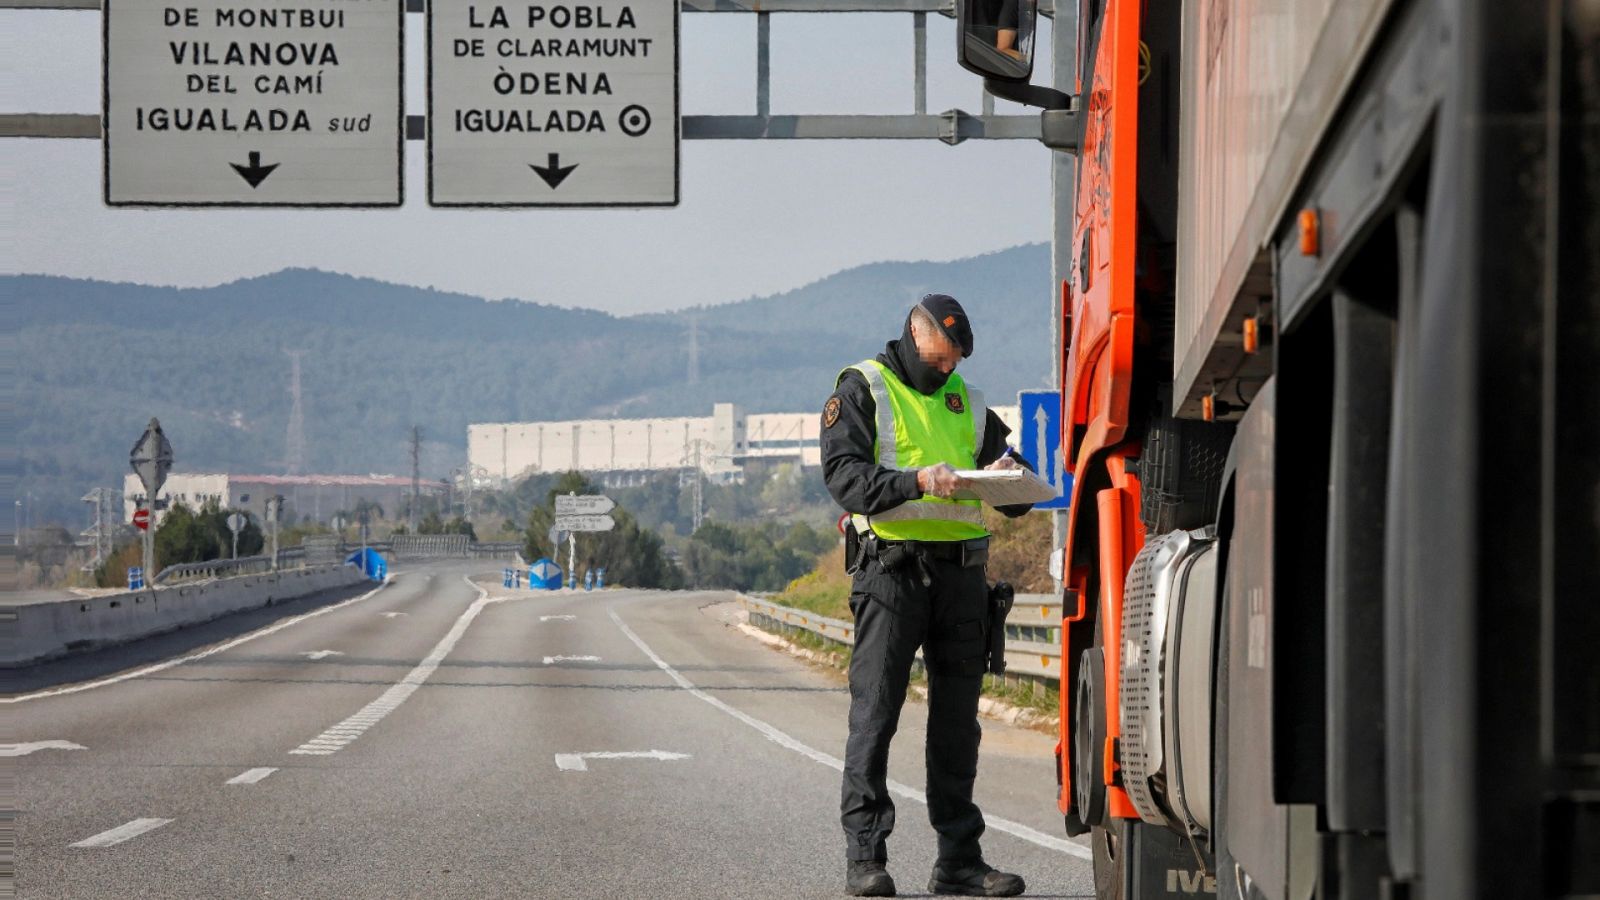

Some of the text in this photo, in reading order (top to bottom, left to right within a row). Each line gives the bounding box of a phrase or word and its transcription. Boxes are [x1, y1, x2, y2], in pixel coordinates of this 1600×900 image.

[163, 7, 345, 29] DE MONTBUI
[468, 5, 637, 29] LA POBLA
[168, 40, 340, 67] VILANOVA
[453, 38, 653, 58] DE CLARAMUNT
[186, 70, 324, 95] DEL CAMÍ
[493, 65, 613, 96] ÒDENA
[135, 106, 373, 133] IGUALADA sud
[455, 108, 607, 133] IGUALADA
